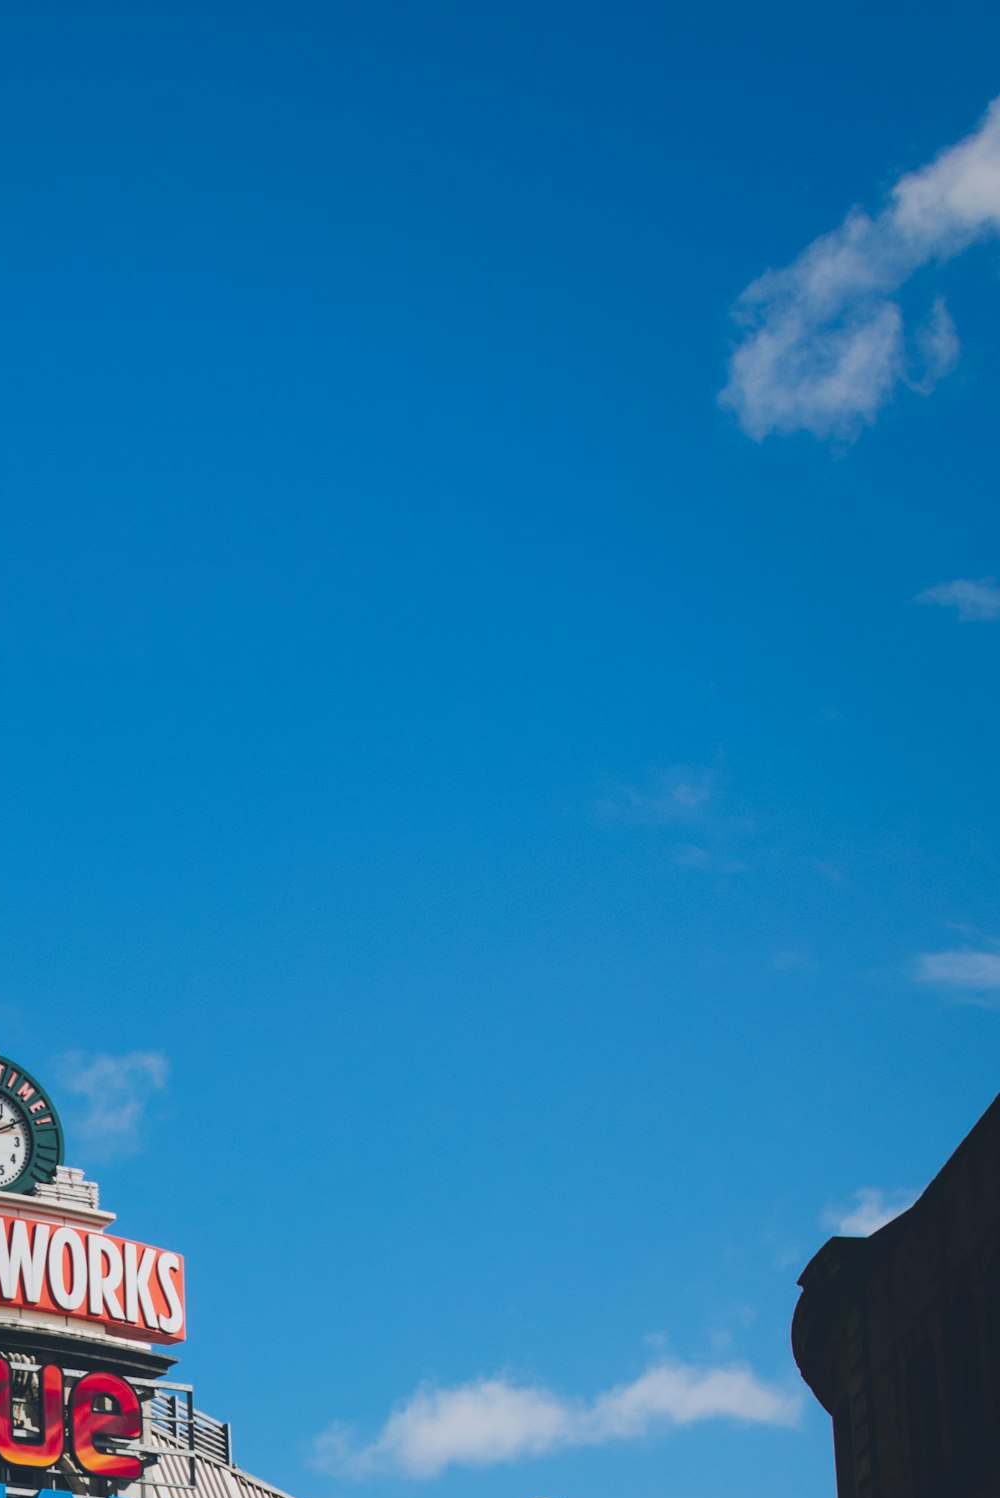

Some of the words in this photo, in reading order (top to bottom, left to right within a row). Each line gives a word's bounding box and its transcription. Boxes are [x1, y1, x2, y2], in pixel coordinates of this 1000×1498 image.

[14, 1137, 20, 1147] 3
[10, 1153, 17, 1164] 4
[0, 1165, 5, 1175] 5
